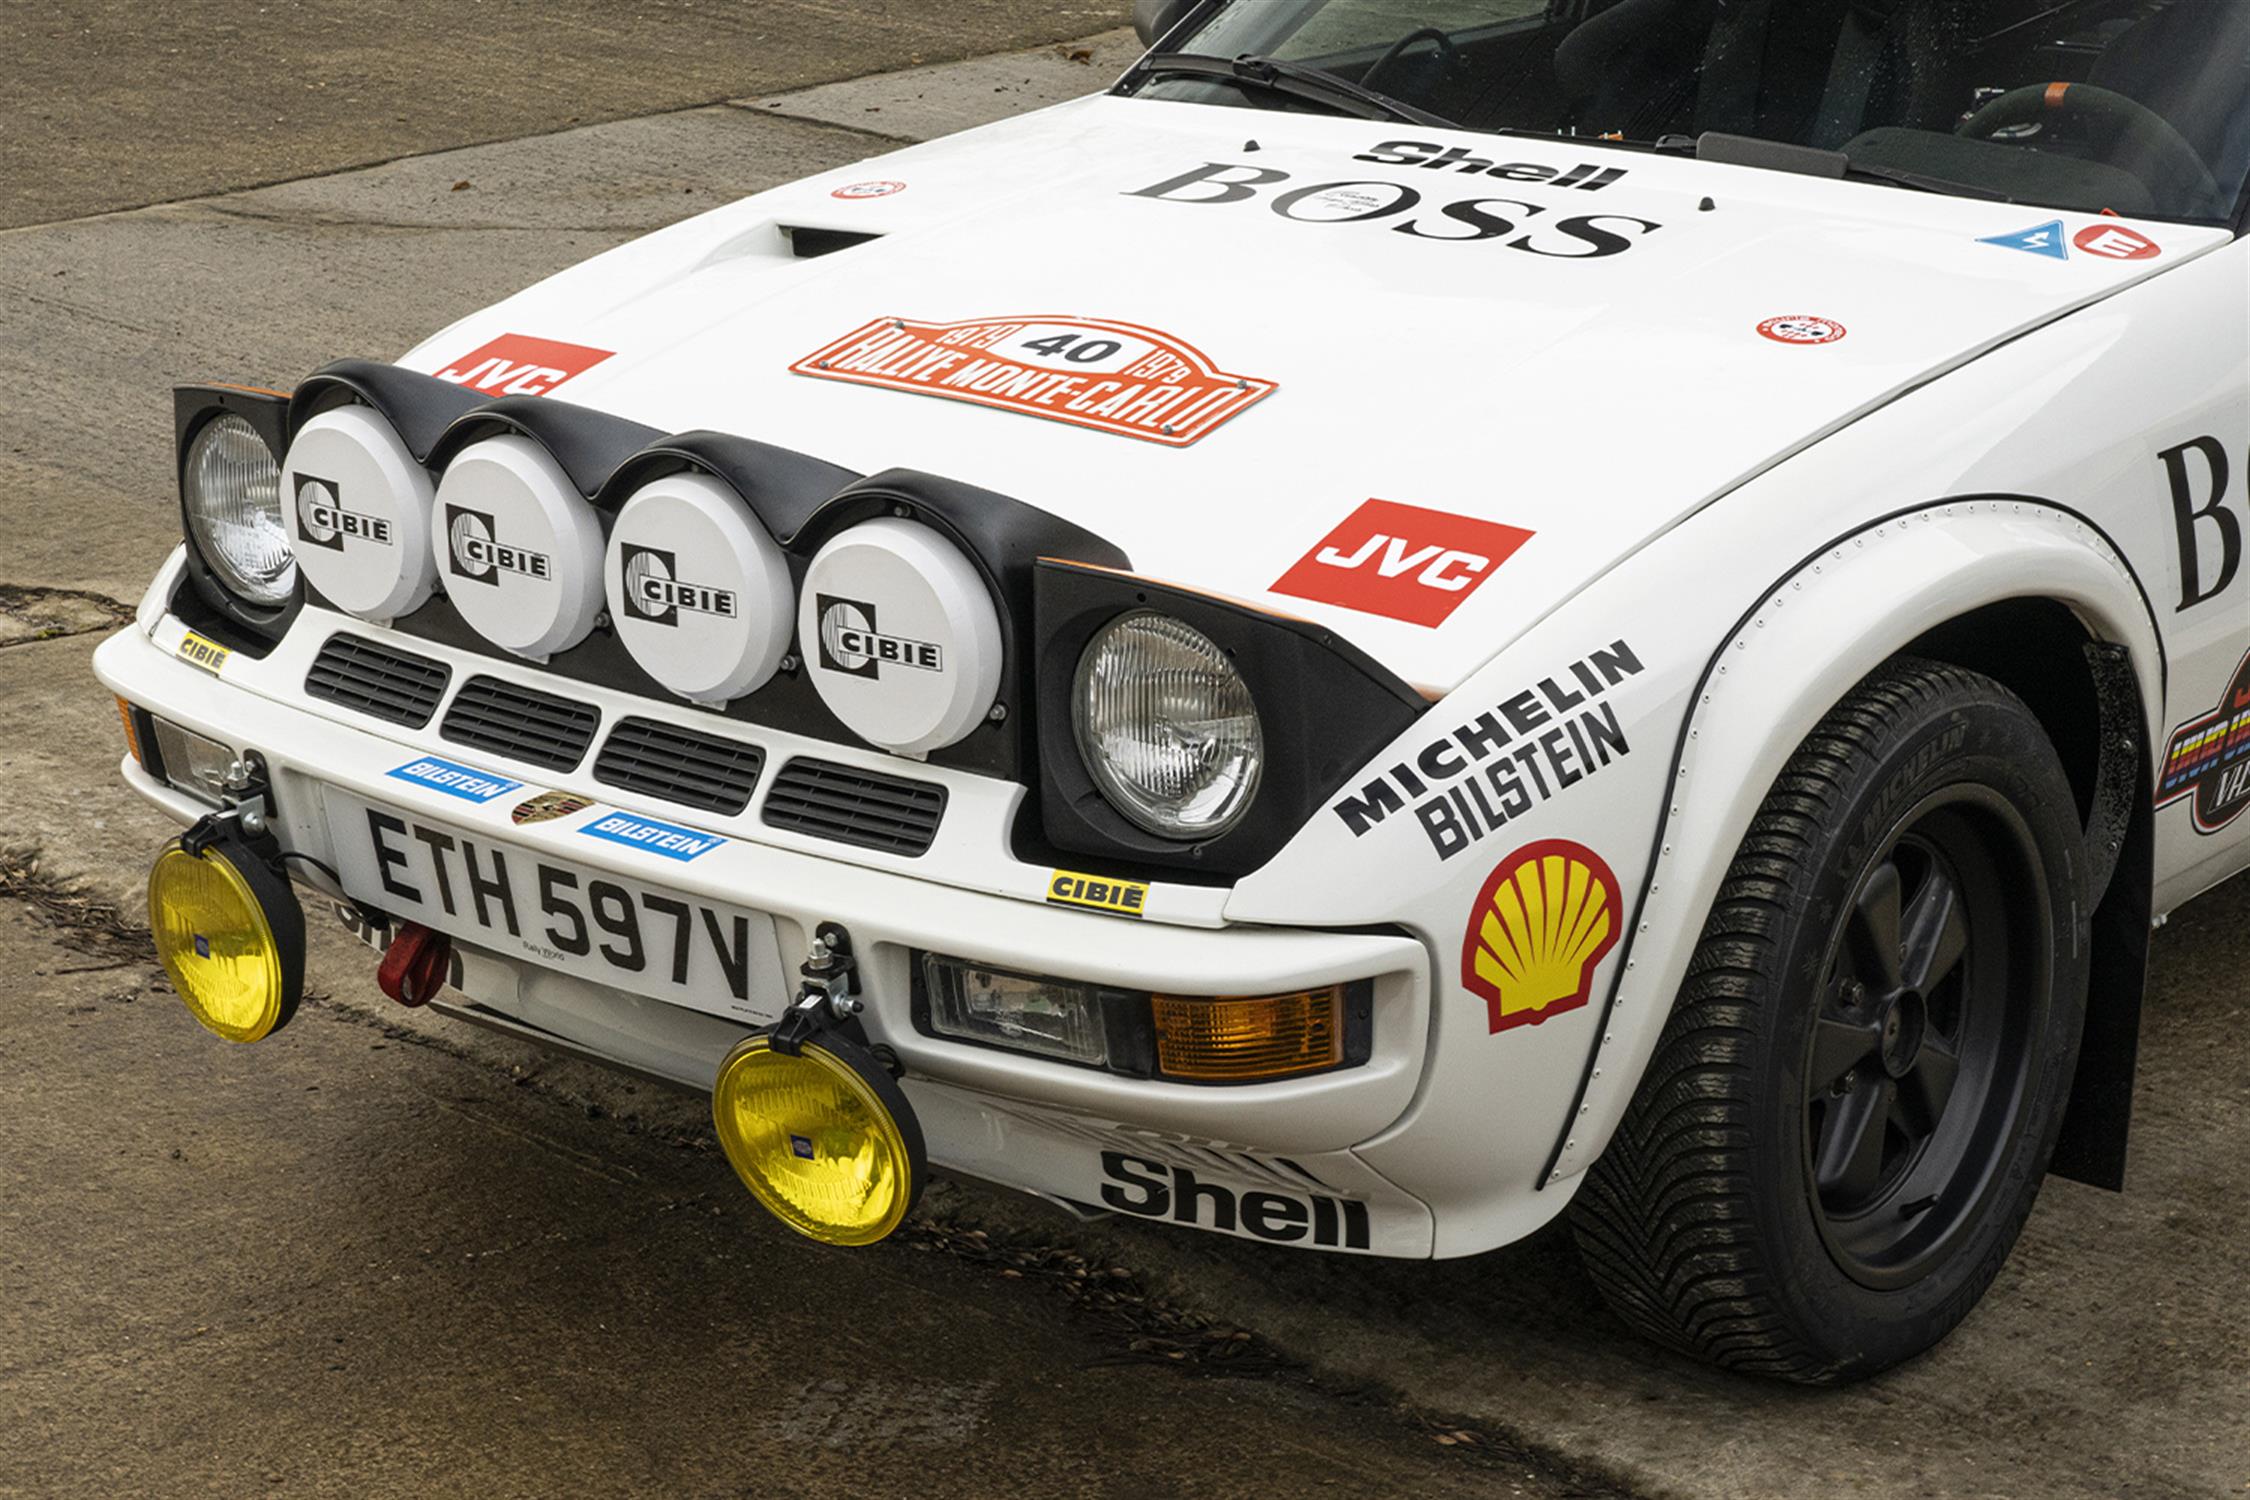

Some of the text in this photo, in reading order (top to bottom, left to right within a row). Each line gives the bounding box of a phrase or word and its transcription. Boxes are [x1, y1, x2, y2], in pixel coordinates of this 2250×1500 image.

[1119, 162, 1663, 258] BOSS
[1352, 141, 1639, 191] Shell
[437, 357, 568, 397] JVC
[823, 328, 970, 382] RALLYE
[939, 358, 1249, 431] MONTE-CARLO
[934, 324, 1025, 350] 1979
[1020, 333, 1122, 363] 40
[1122, 347, 1192, 384] 1979
[1315, 533, 1490, 592] JVC
[2157, 434, 2250, 614] B
[1332, 638, 1645, 838] MICHELIN
[1414, 701, 1631, 861] BILSTEIN
[1861, 721, 1969, 845] MICHELIN
[365, 807, 522, 938] ETH
[537, 863, 749, 1001] 597V
[1100, 1150, 1371, 1250] Shell
